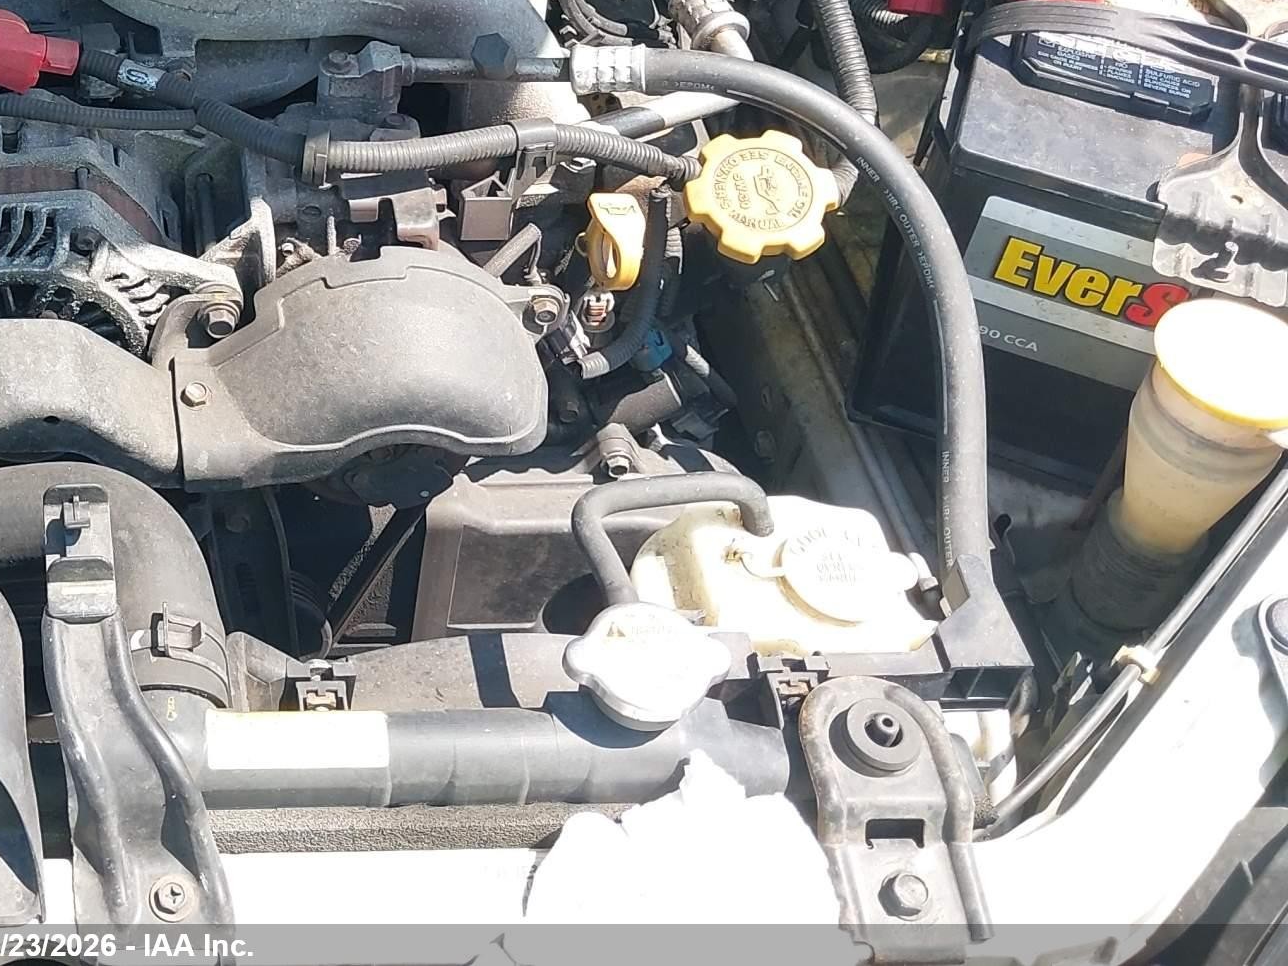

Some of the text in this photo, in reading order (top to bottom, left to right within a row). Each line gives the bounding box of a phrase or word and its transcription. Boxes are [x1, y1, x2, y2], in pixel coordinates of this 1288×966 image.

[1145, 69, 1200, 87] SULFURIC ACID
[738, 150, 770, 162] SEE
[712, 157, 739, 211] OWNER'S
[855, 156, 881, 184] INNER
[898, 213, 920, 249] OUTER
[1004, 333, 1039, 353] CCA
[941, 451, 951, 483] INNER
[944, 526, 954, 569] OUTER
